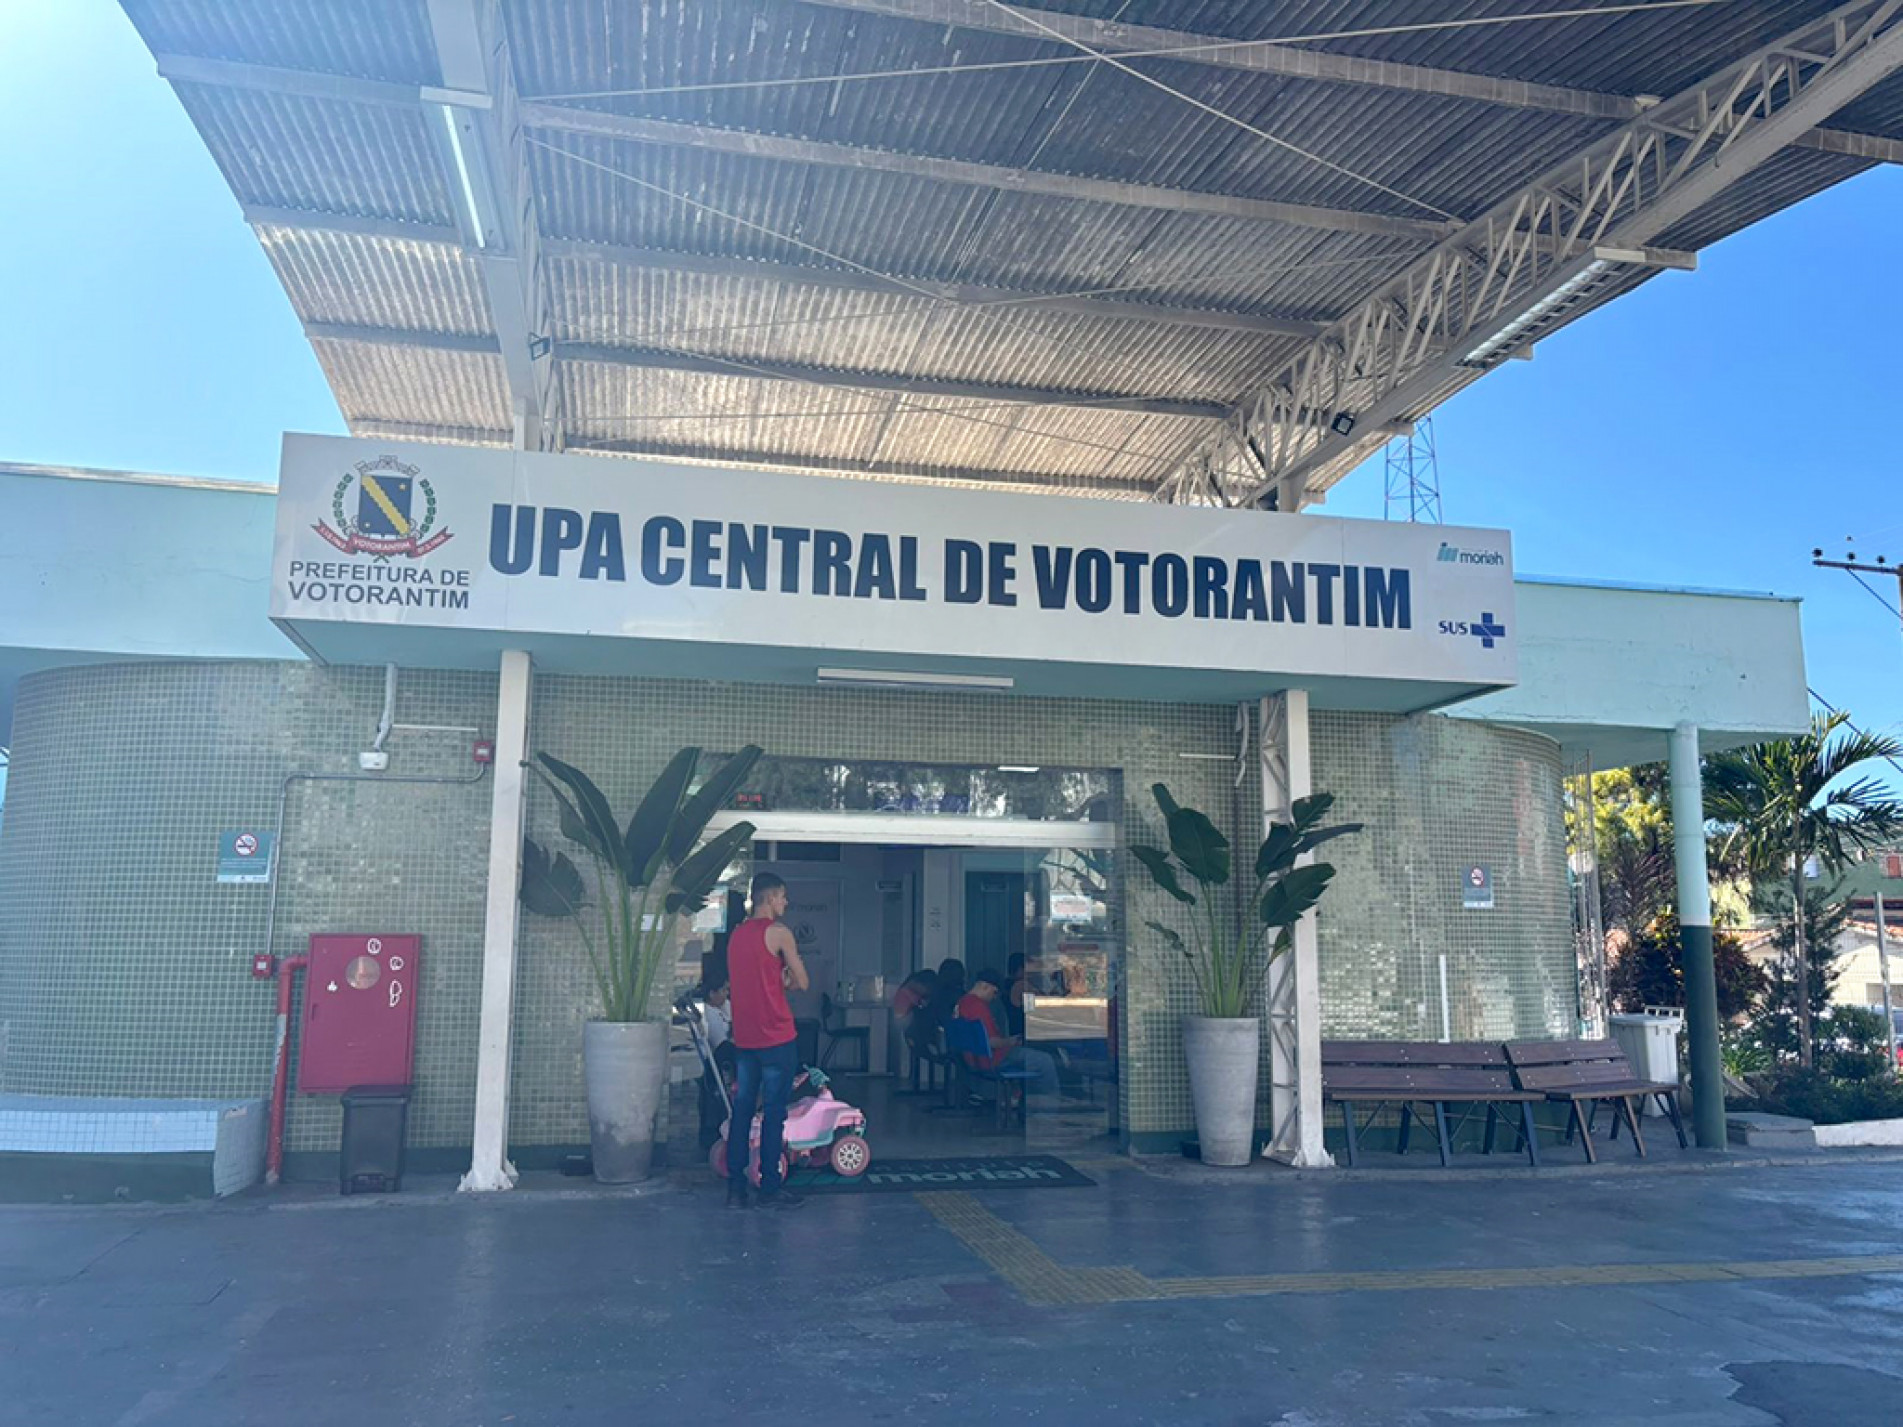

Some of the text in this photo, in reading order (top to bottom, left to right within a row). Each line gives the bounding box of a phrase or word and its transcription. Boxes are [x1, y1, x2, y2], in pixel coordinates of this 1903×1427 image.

[490, 503, 1412, 629] UPA CENTRAL DE VOTORANTIM
[1459, 549, 1504, 566] moriah
[289, 560, 470, 587] PREFEITURA DE
[288, 580, 469, 609] VOTORANTIM
[1438, 620, 1468, 635] SUS
[867, 1166, 1062, 1183] moriah
